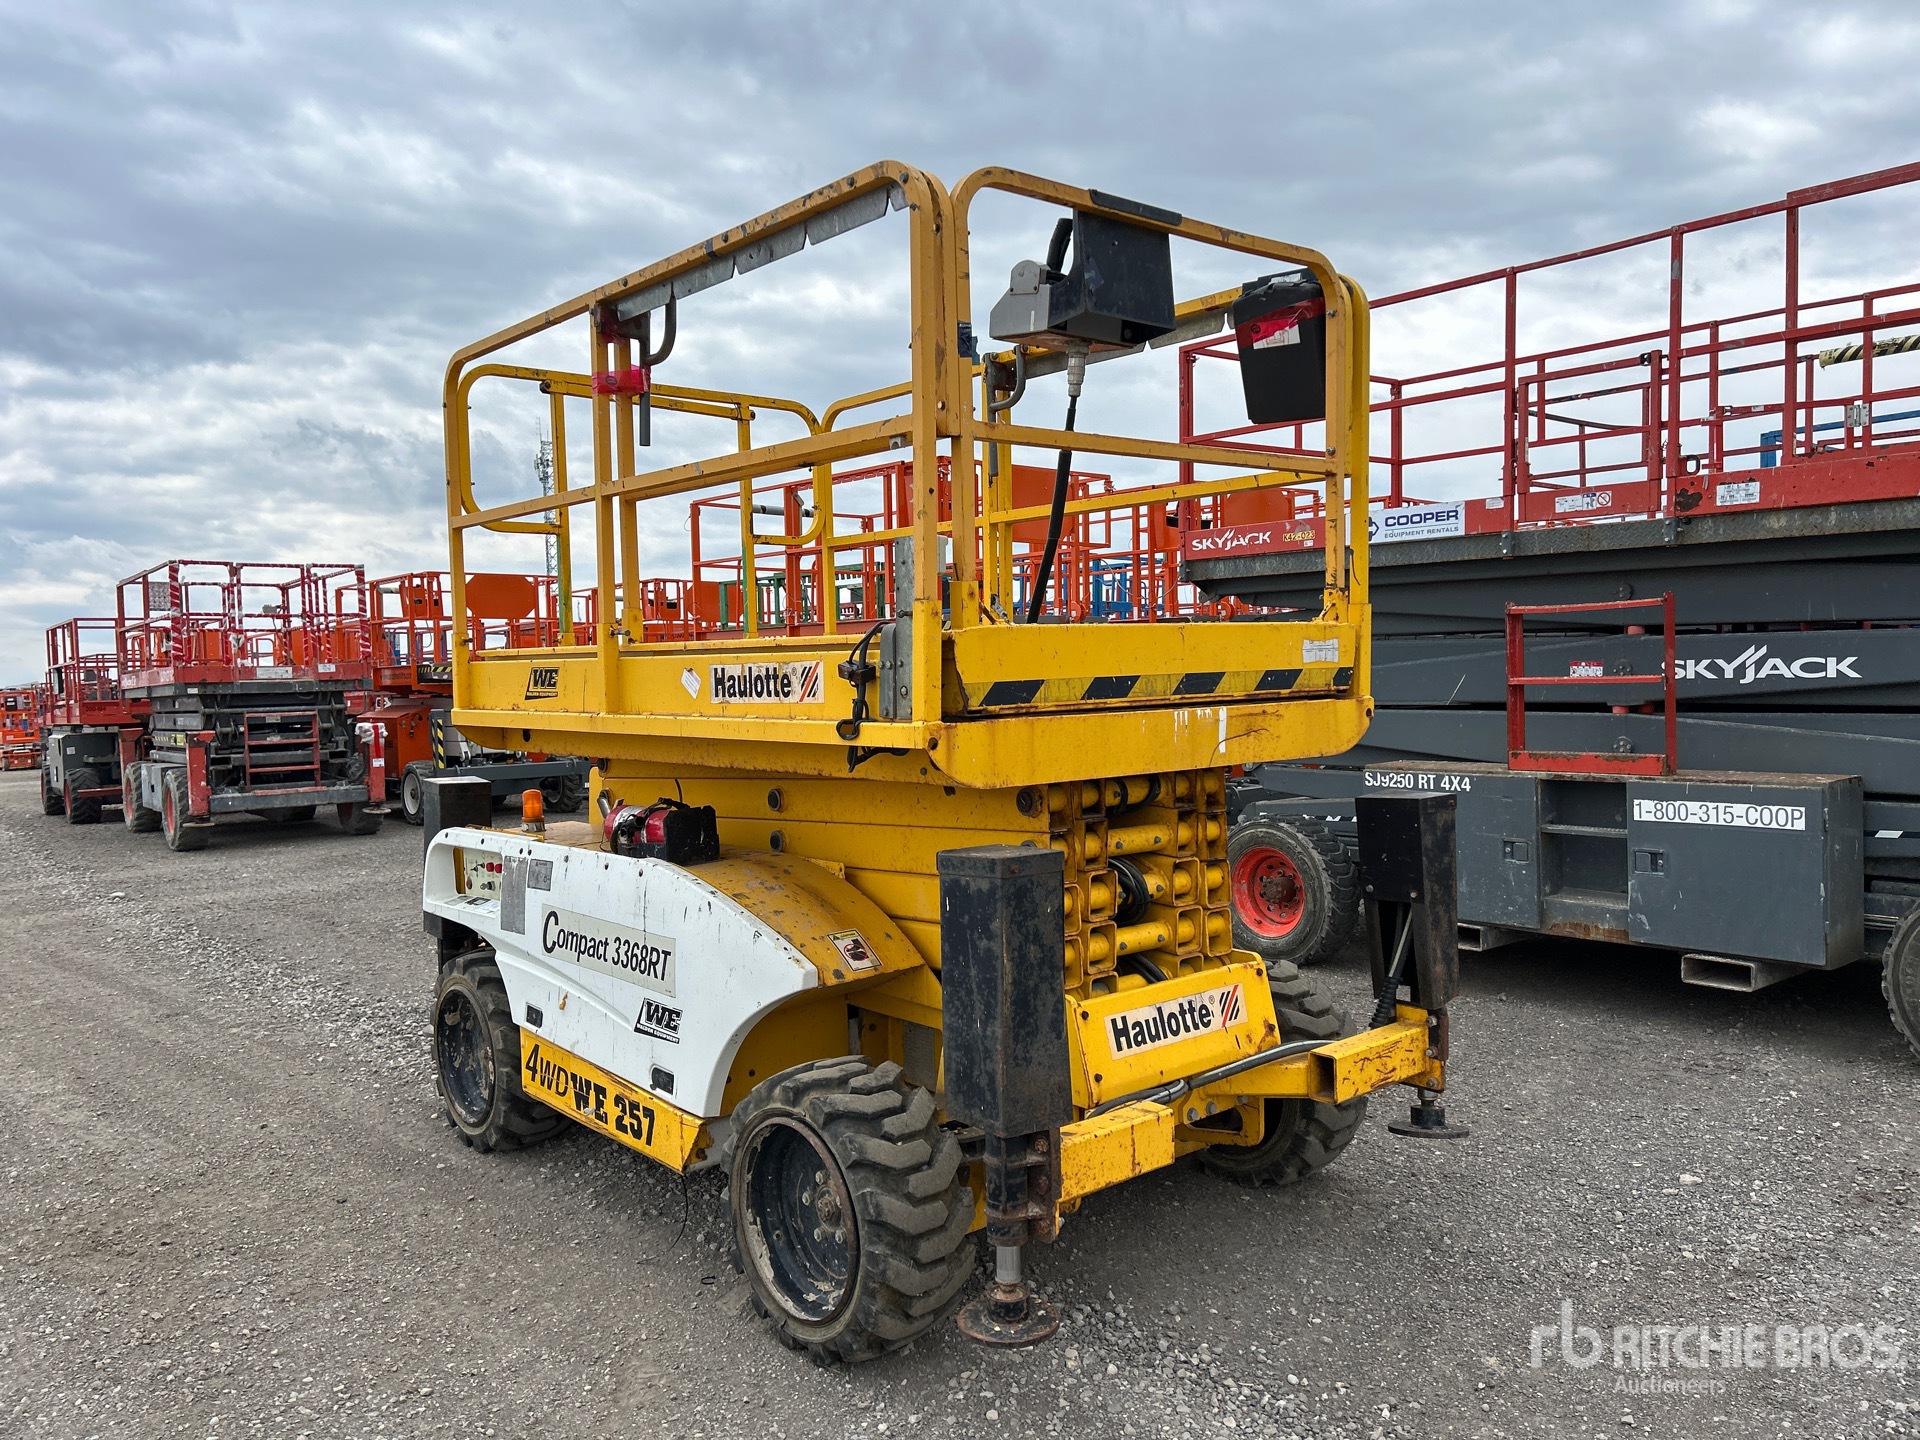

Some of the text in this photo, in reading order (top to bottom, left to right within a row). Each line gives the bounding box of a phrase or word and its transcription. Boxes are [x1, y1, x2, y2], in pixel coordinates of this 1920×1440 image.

[1384, 509, 1459, 527] COOPER
[1384, 526, 1459, 538] EQUIPMENT RENTALS
[1192, 528, 1271, 551] SKYJACK
[531, 668, 558, 689] WE
[1661, 644, 1862, 684] SKYJACK
[713, 666, 792, 698] Haulotte
[1418, 774, 1436, 789] RT
[1440, 775, 1471, 792] 4X4
[1635, 801, 1803, 828] 1-800-315-COOP
[543, 911, 672, 981] Compact 3368RT
[645, 1000, 682, 1034] WE
[1110, 999, 1212, 1053] Haulotte
[525, 1043, 655, 1147] 4WD WE 257
